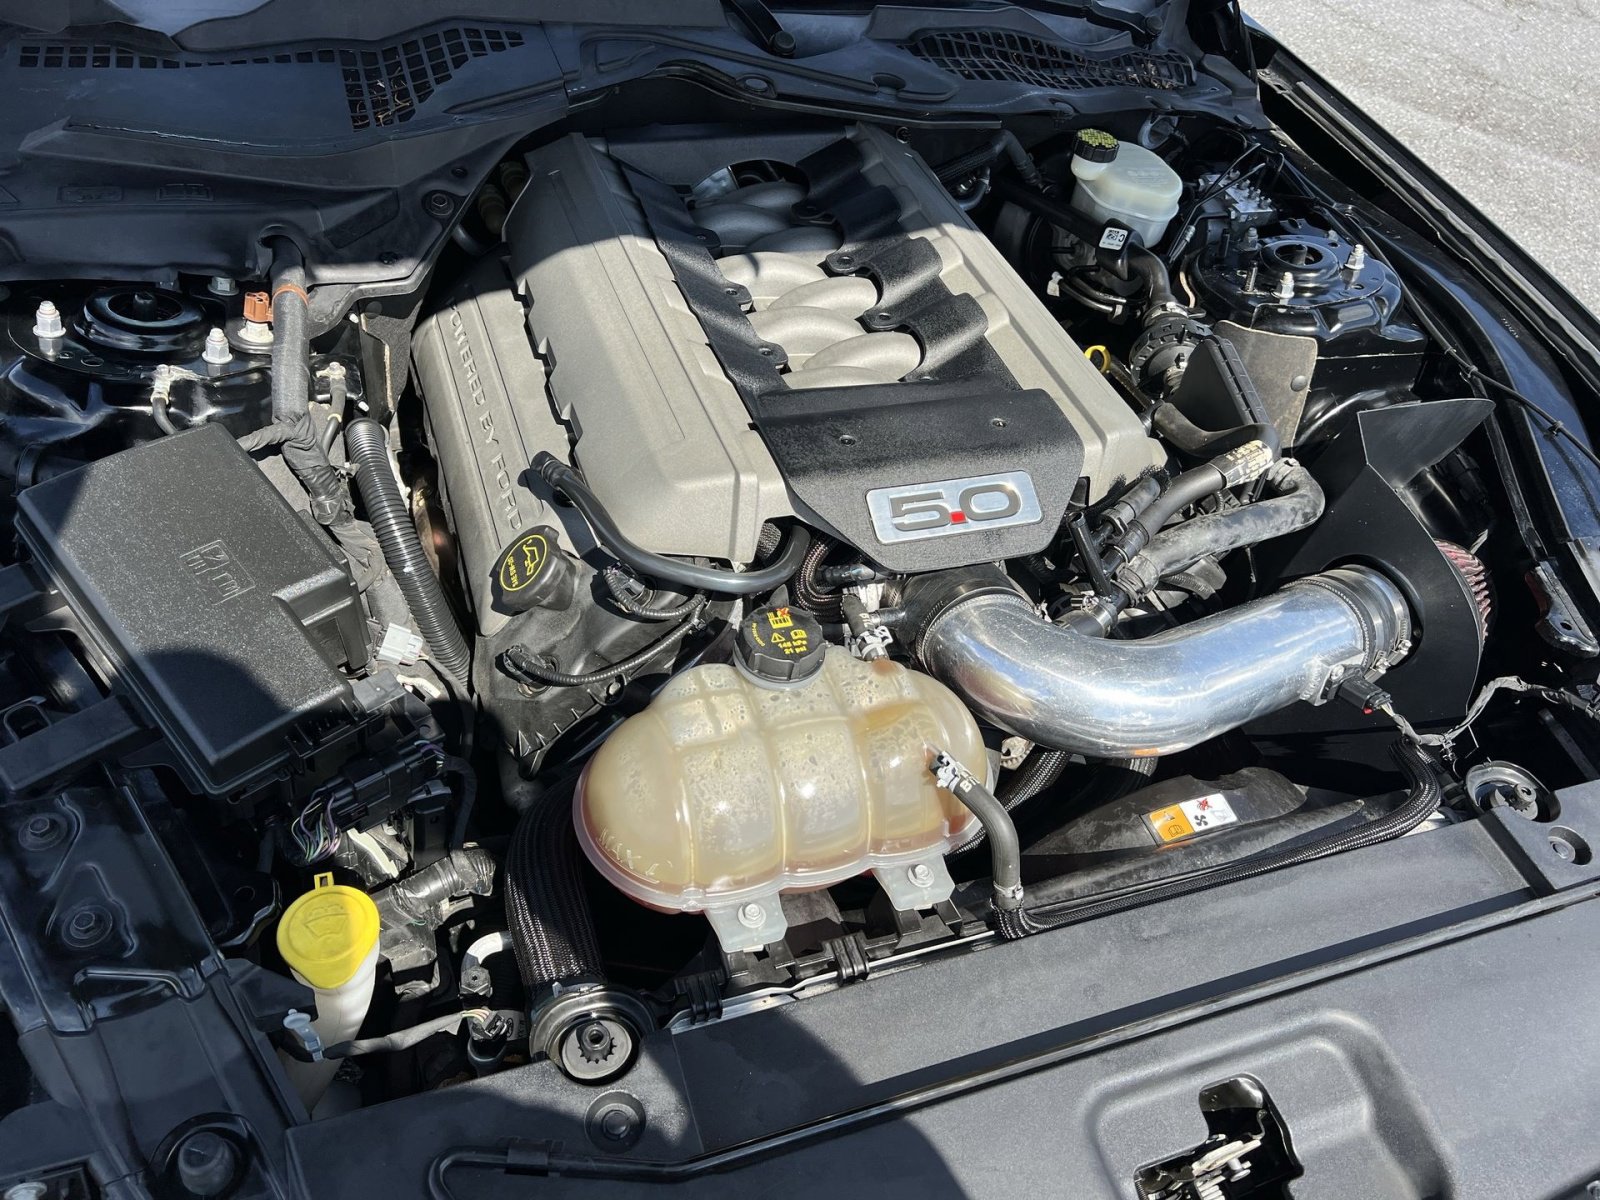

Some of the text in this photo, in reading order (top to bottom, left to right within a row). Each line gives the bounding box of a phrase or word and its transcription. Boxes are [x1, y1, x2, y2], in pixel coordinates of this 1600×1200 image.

[479, 411, 499, 444] BY
[491, 453, 523, 530] FORD
[889, 482, 1022, 532] 5.0
[784, 646, 807, 655] 21 psi
